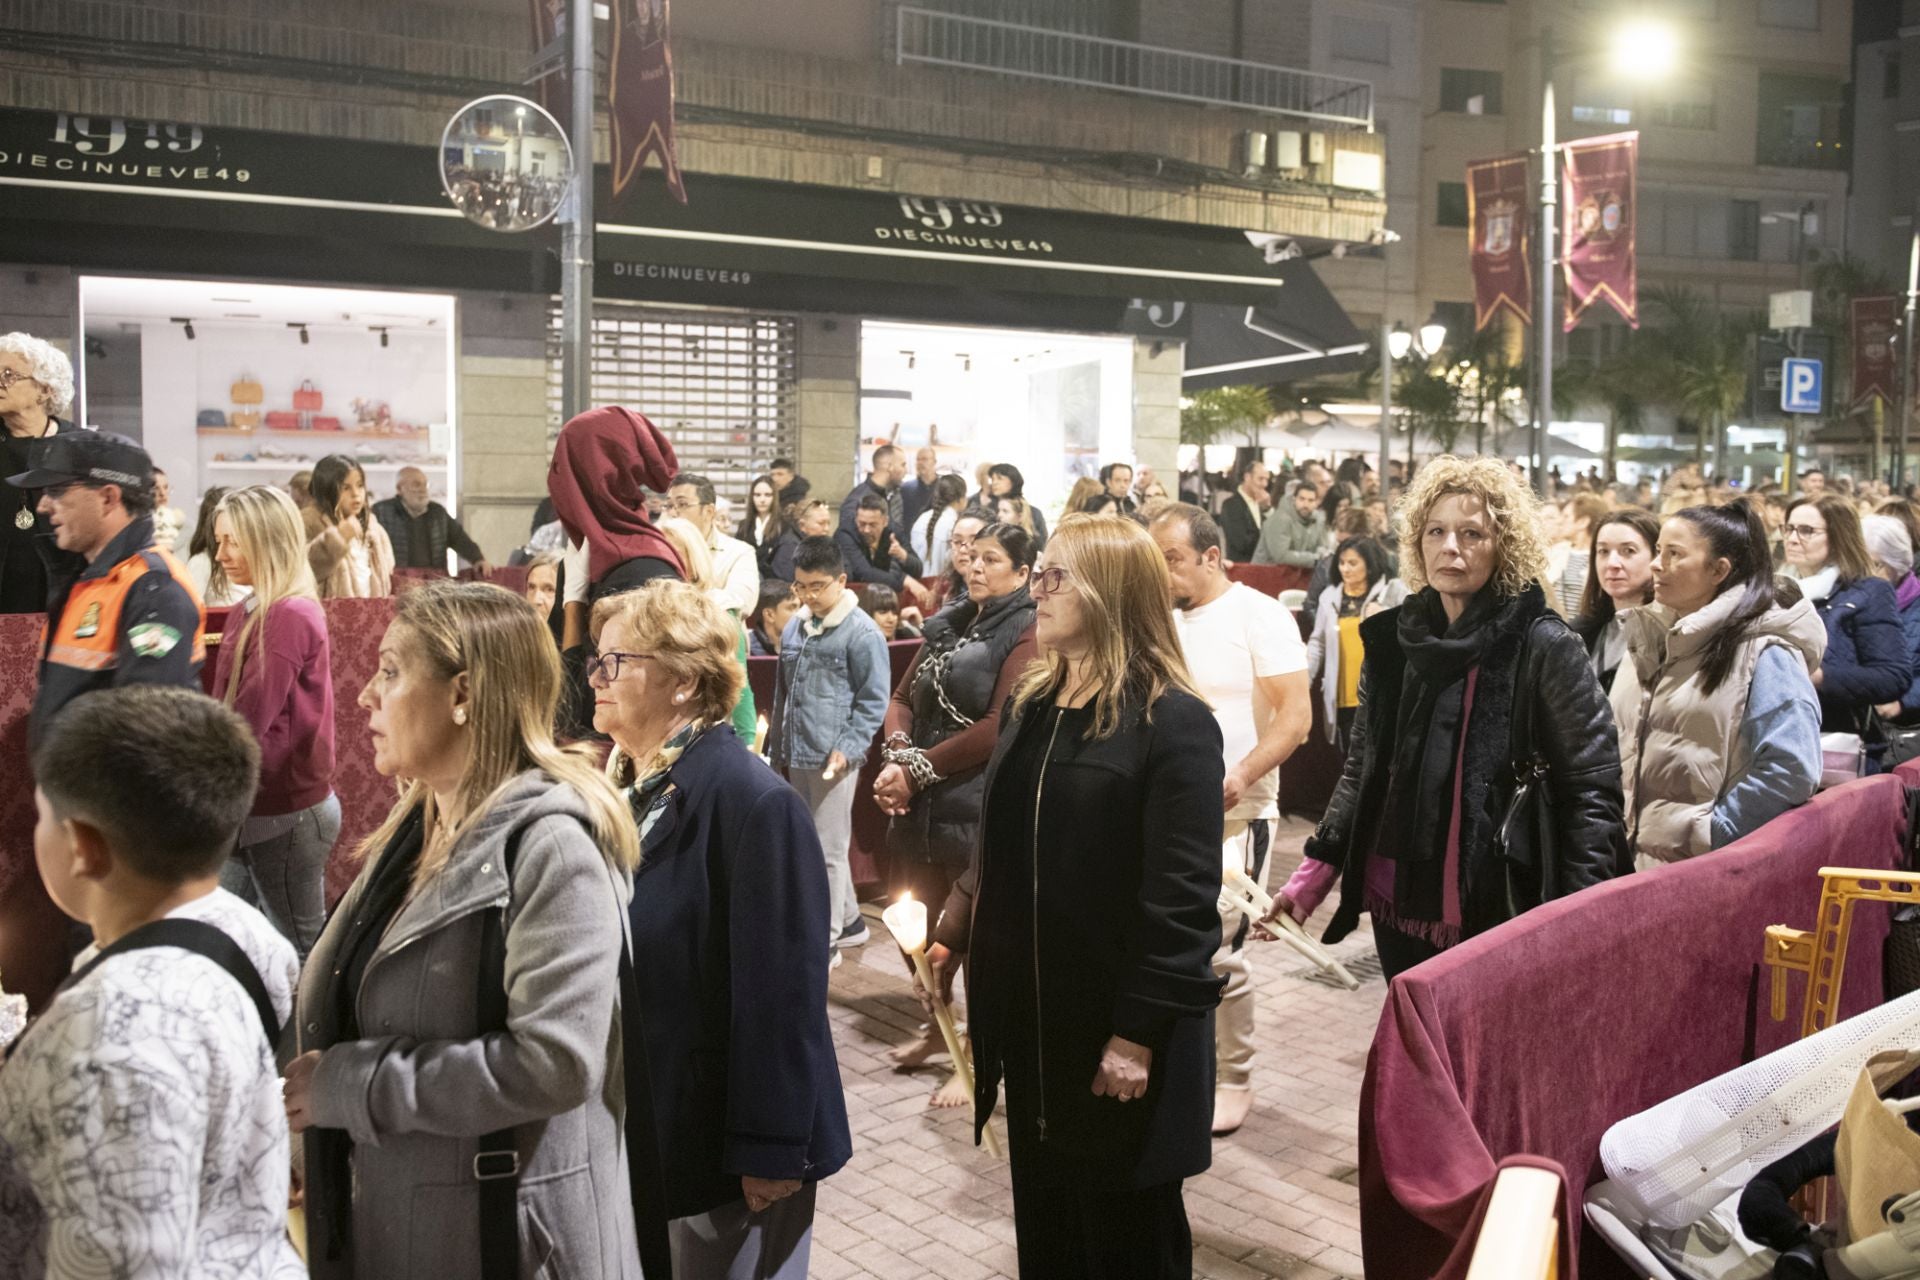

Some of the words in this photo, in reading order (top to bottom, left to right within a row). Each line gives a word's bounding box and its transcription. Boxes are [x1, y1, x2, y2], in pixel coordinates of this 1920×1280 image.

[875, 227, 1053, 252] DIECINUEVE49
[613, 262, 751, 284] DIECINUEVE49
[1791, 365, 1814, 406] P
